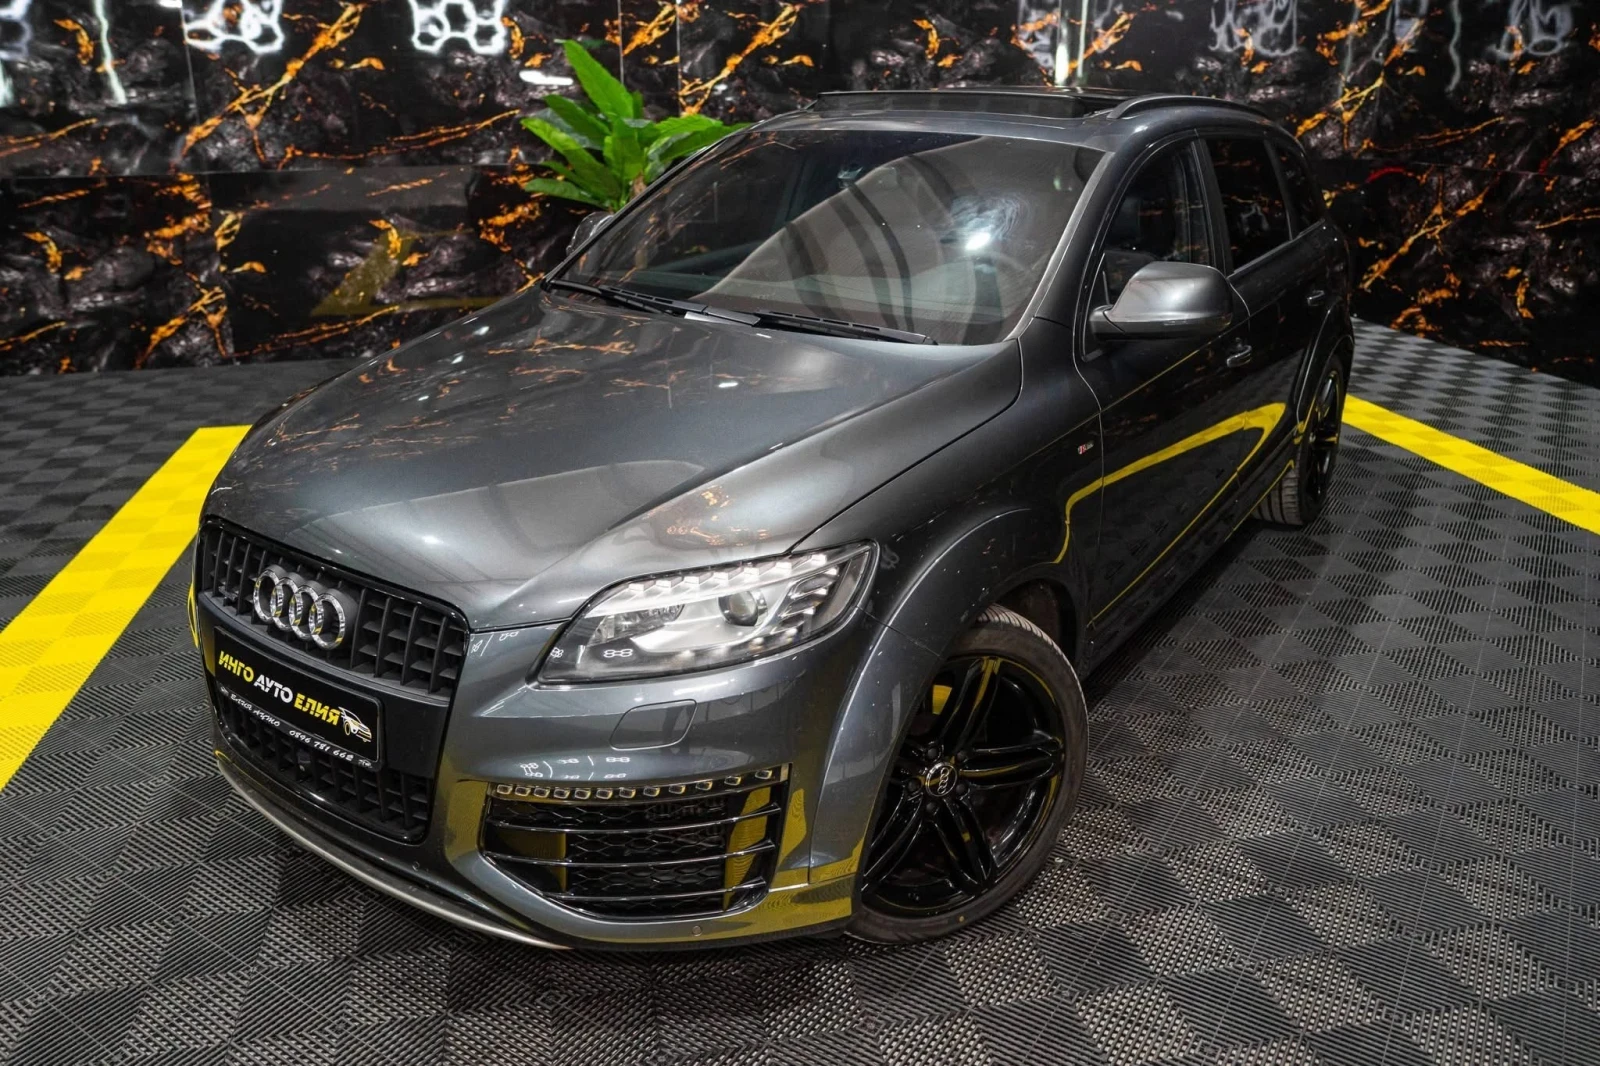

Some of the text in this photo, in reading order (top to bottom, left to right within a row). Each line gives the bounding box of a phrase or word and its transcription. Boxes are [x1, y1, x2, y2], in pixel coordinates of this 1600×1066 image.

[218, 650, 341, 726] ИНГО АУТО ЕЛИЯ
[289, 730, 311, 744] 0896
[313, 741, 331, 752] 781
